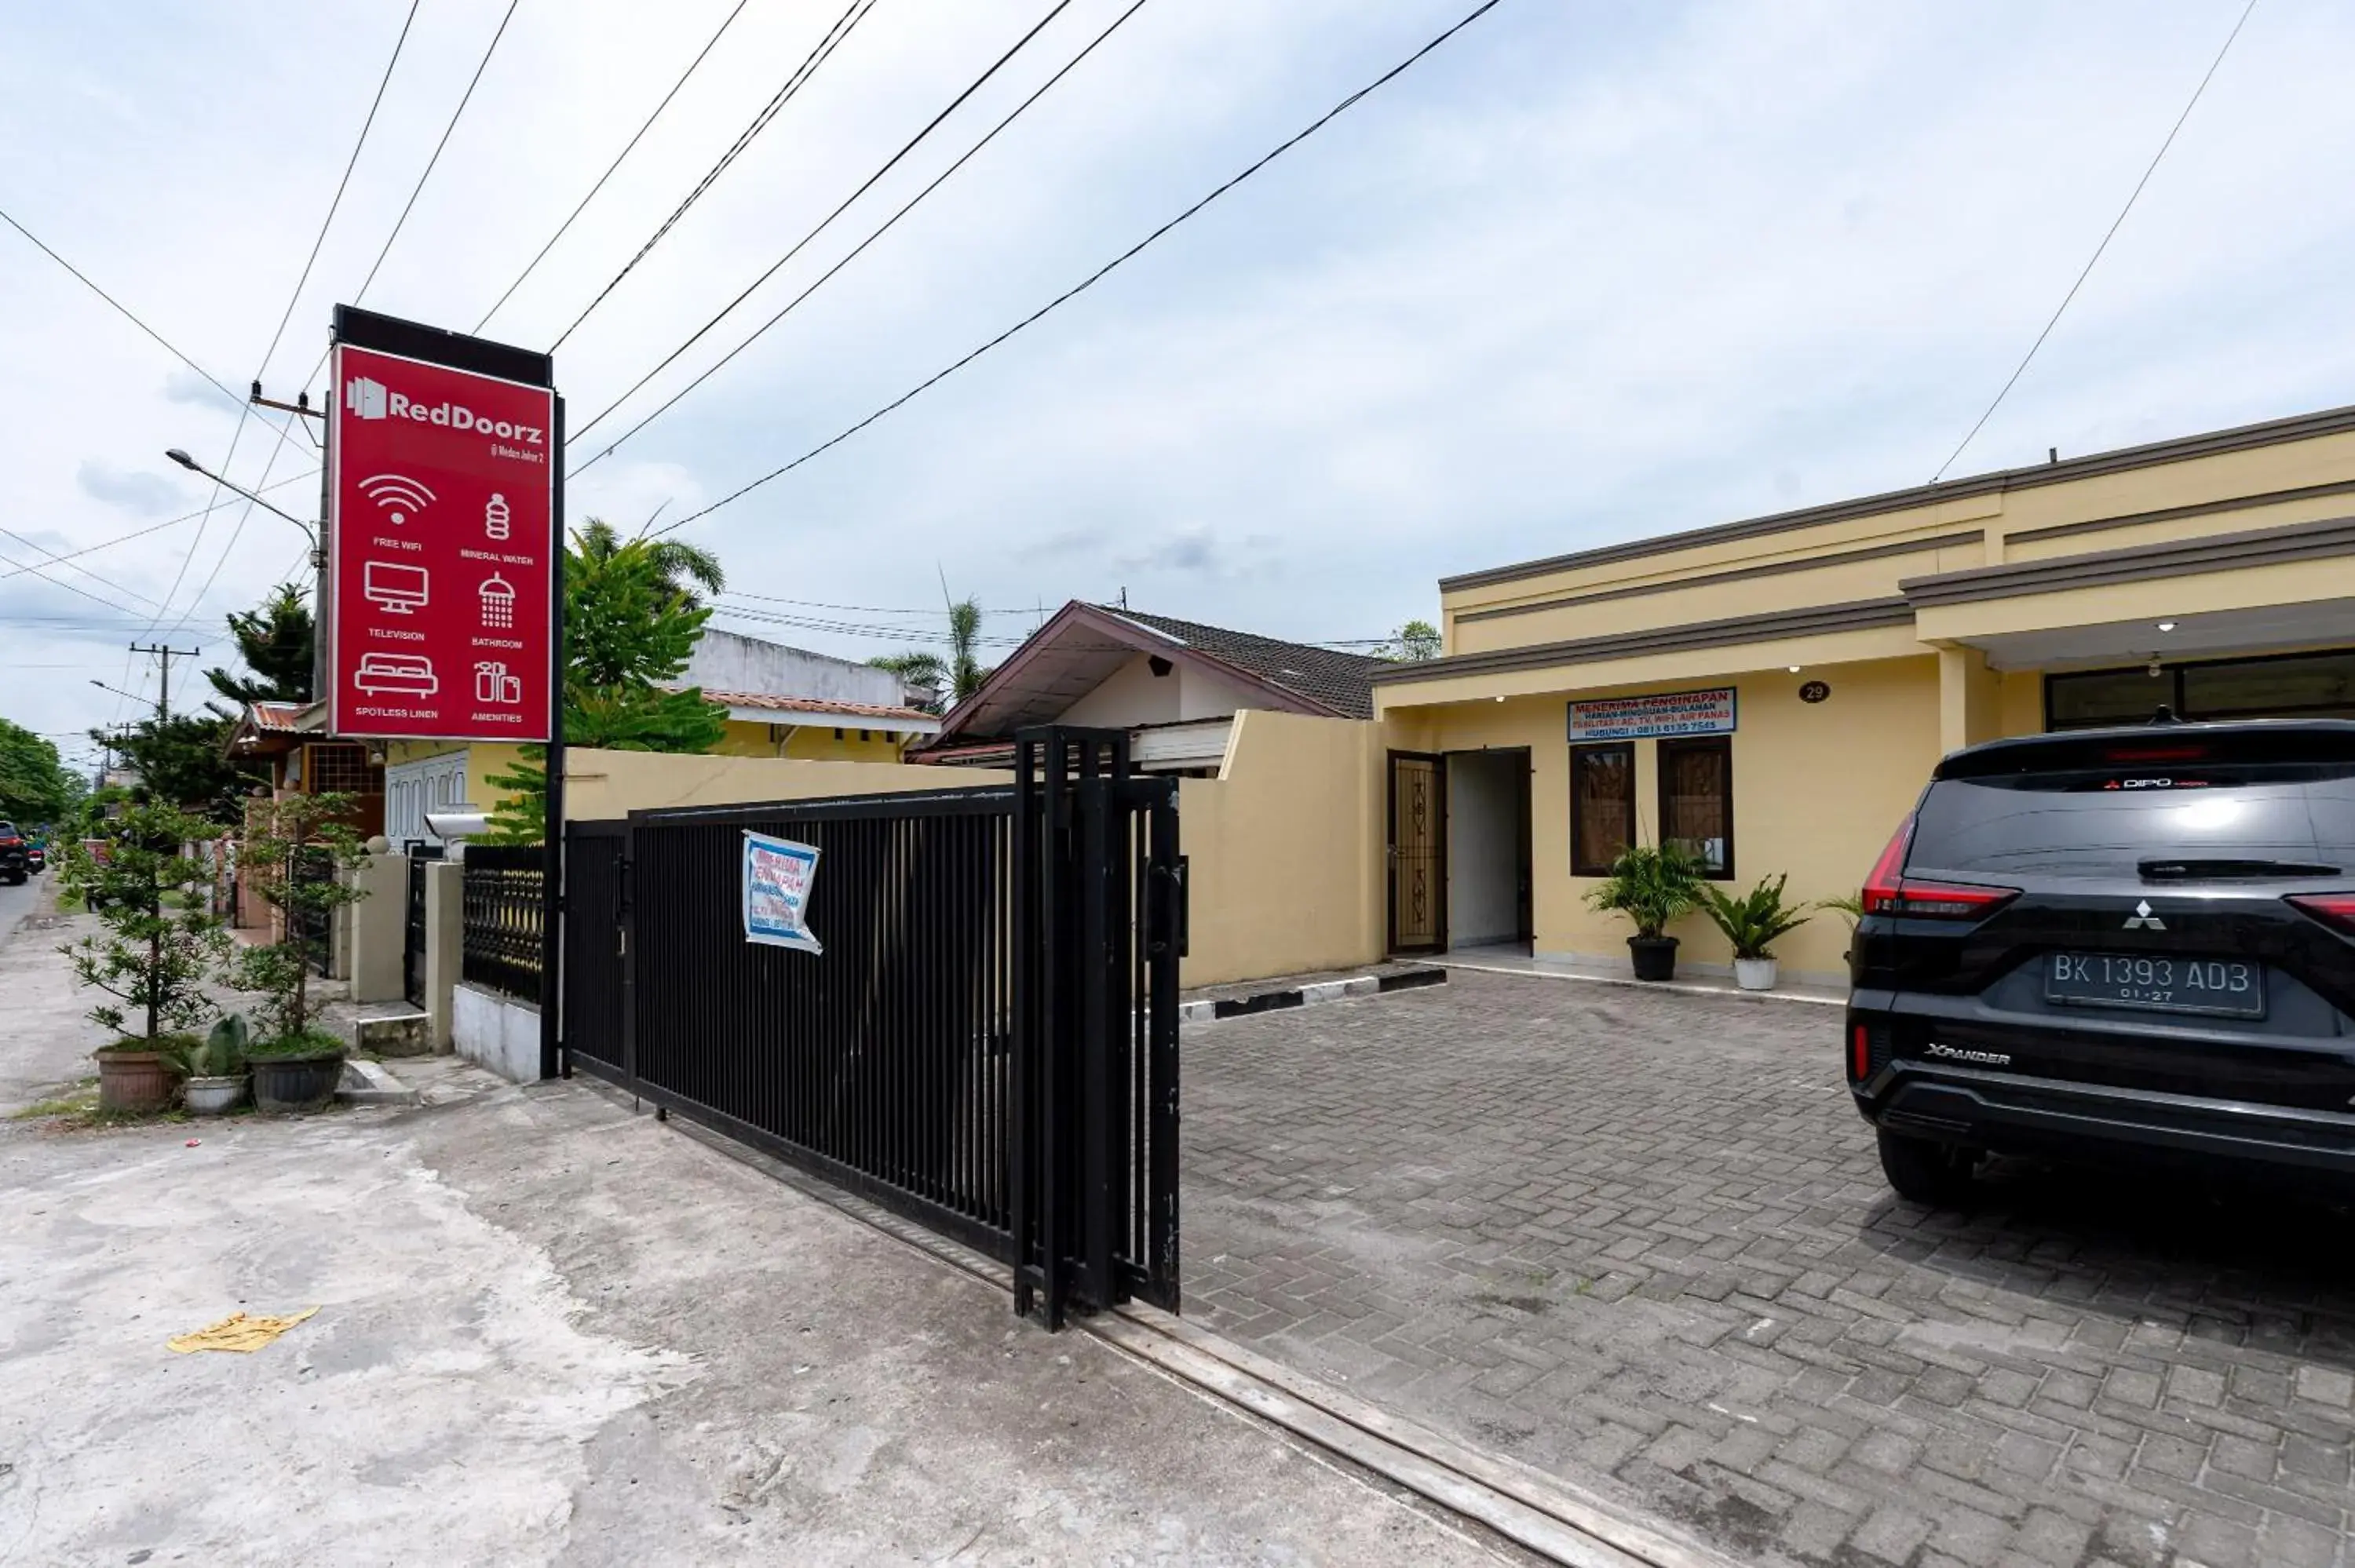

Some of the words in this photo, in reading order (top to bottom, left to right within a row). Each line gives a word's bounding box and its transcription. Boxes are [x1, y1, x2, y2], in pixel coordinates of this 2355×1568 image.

[390, 392, 542, 443] RedDoorz
[373, 537, 399, 549] FREE
[401, 540, 422, 551] WIFI
[461, 549, 500, 562] MINERAL
[502, 553, 534, 565] WATER
[368, 628, 425, 641] TELEVISION
[472, 638, 523, 649] BATHROOM
[1806, 687, 1823, 698] 29
[1575, 701, 1638, 713] MENERIMA
[1642, 691, 1729, 707] PENGINAPAN
[356, 707, 407, 717] SPOTLESS
[409, 709, 439, 719] LINEN
[471, 713, 522, 723] AMENITIES
[1697, 710, 1729, 719] PANAS
[2055, 954, 2090, 982] BK
[2103, 957, 2173, 986] 1393
[1924, 1043, 2010, 1065] XPANDER
